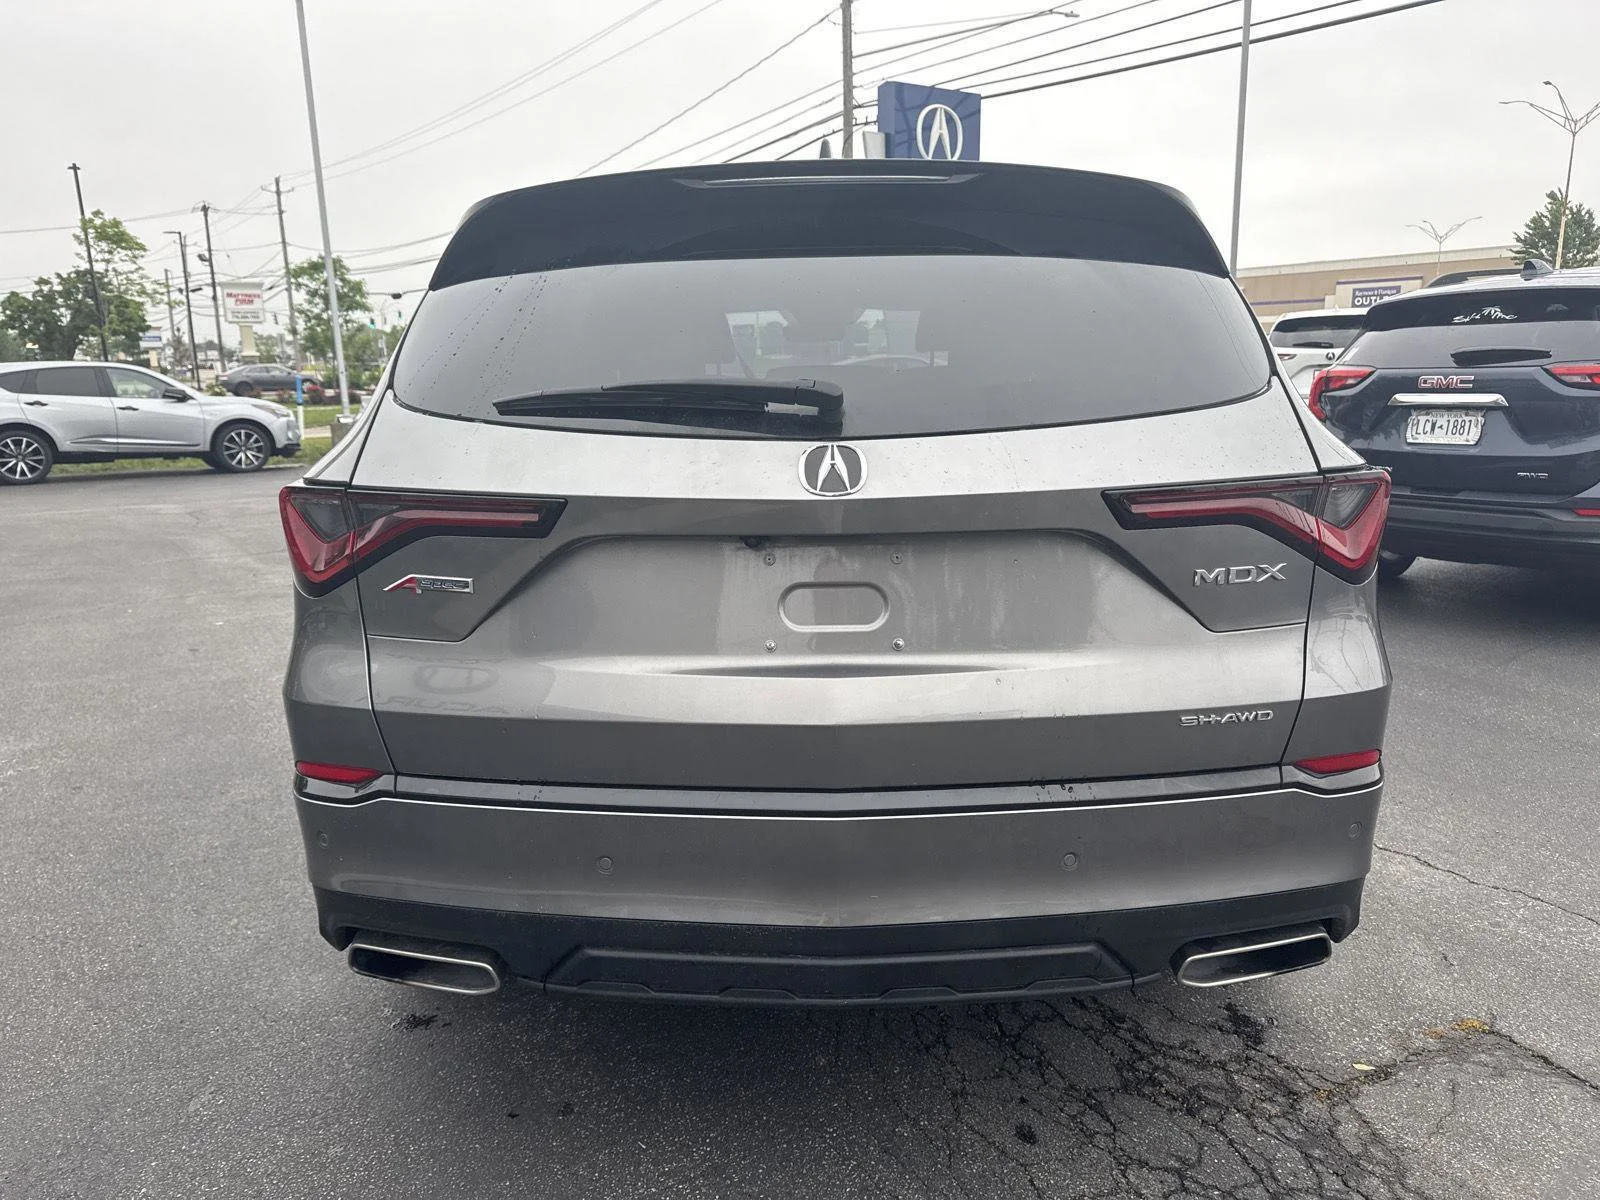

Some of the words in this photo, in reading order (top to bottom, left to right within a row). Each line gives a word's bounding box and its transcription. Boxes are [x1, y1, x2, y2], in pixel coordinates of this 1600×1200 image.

[1418, 375, 1475, 389] GMC
[1194, 562, 1287, 587] MDX
[1180, 710, 1274, 727] SH-AWD
